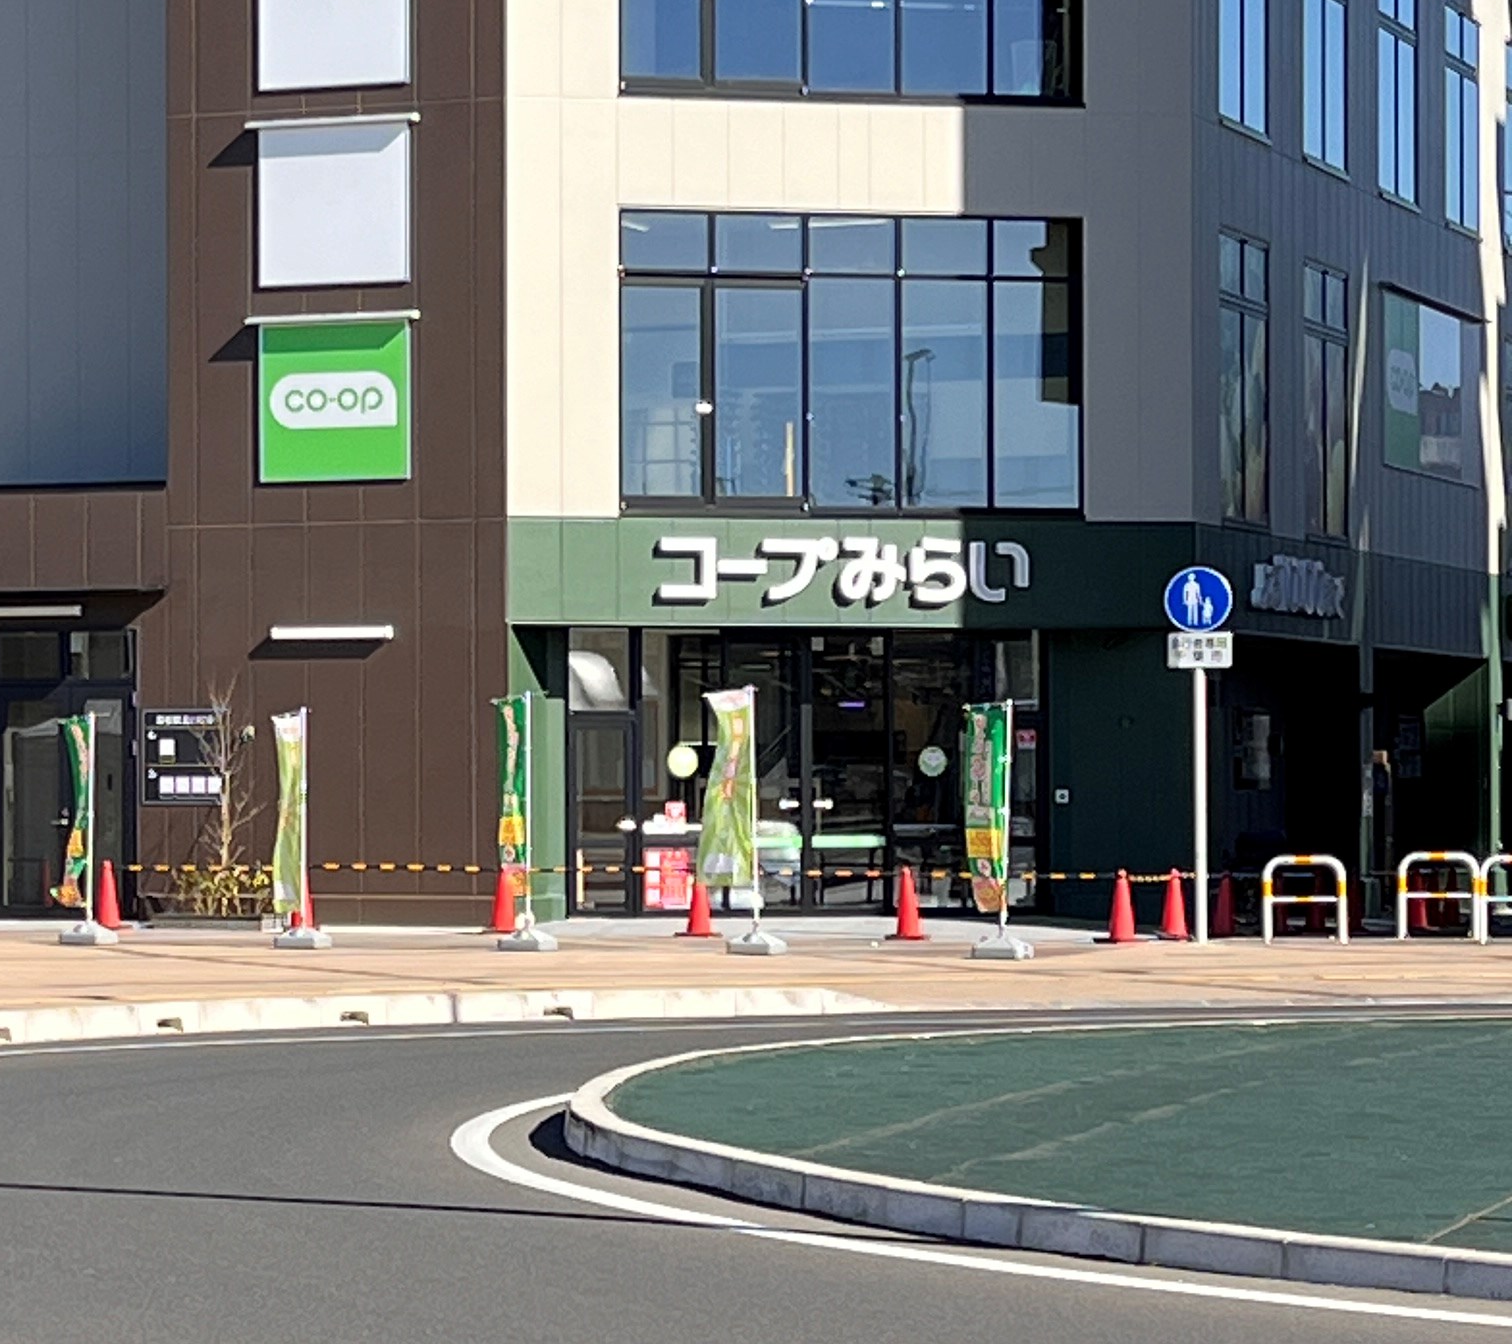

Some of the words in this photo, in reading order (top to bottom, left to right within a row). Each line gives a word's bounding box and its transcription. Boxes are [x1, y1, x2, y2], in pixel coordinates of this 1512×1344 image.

[660, 536, 1030, 603] コープみらい
